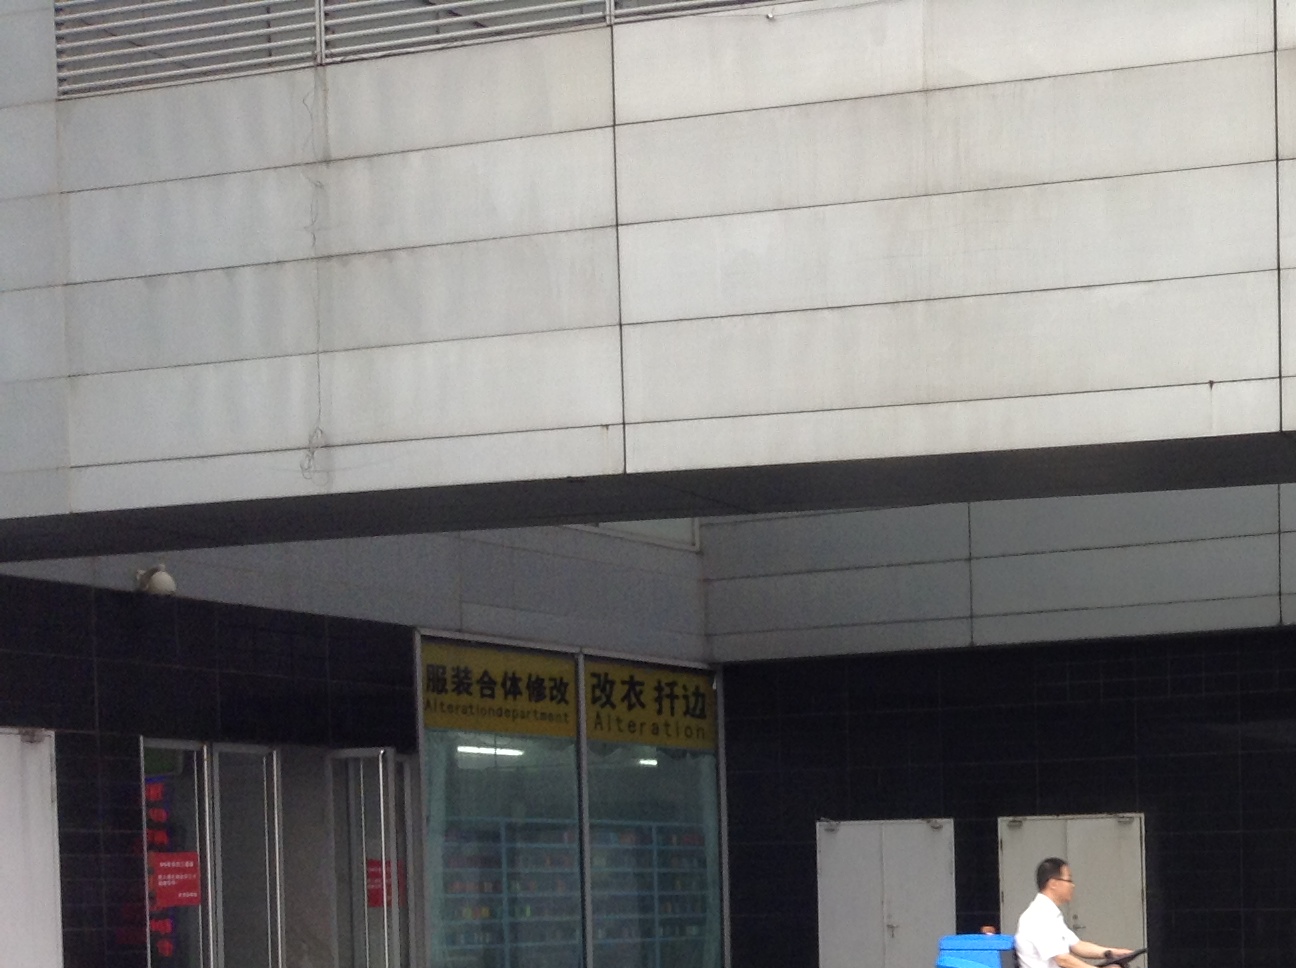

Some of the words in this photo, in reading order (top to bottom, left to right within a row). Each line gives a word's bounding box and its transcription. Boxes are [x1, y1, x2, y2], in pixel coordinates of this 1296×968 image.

[425, 663, 569, 706] 服装合体修改
[594, 713, 706, 739] Alteration
